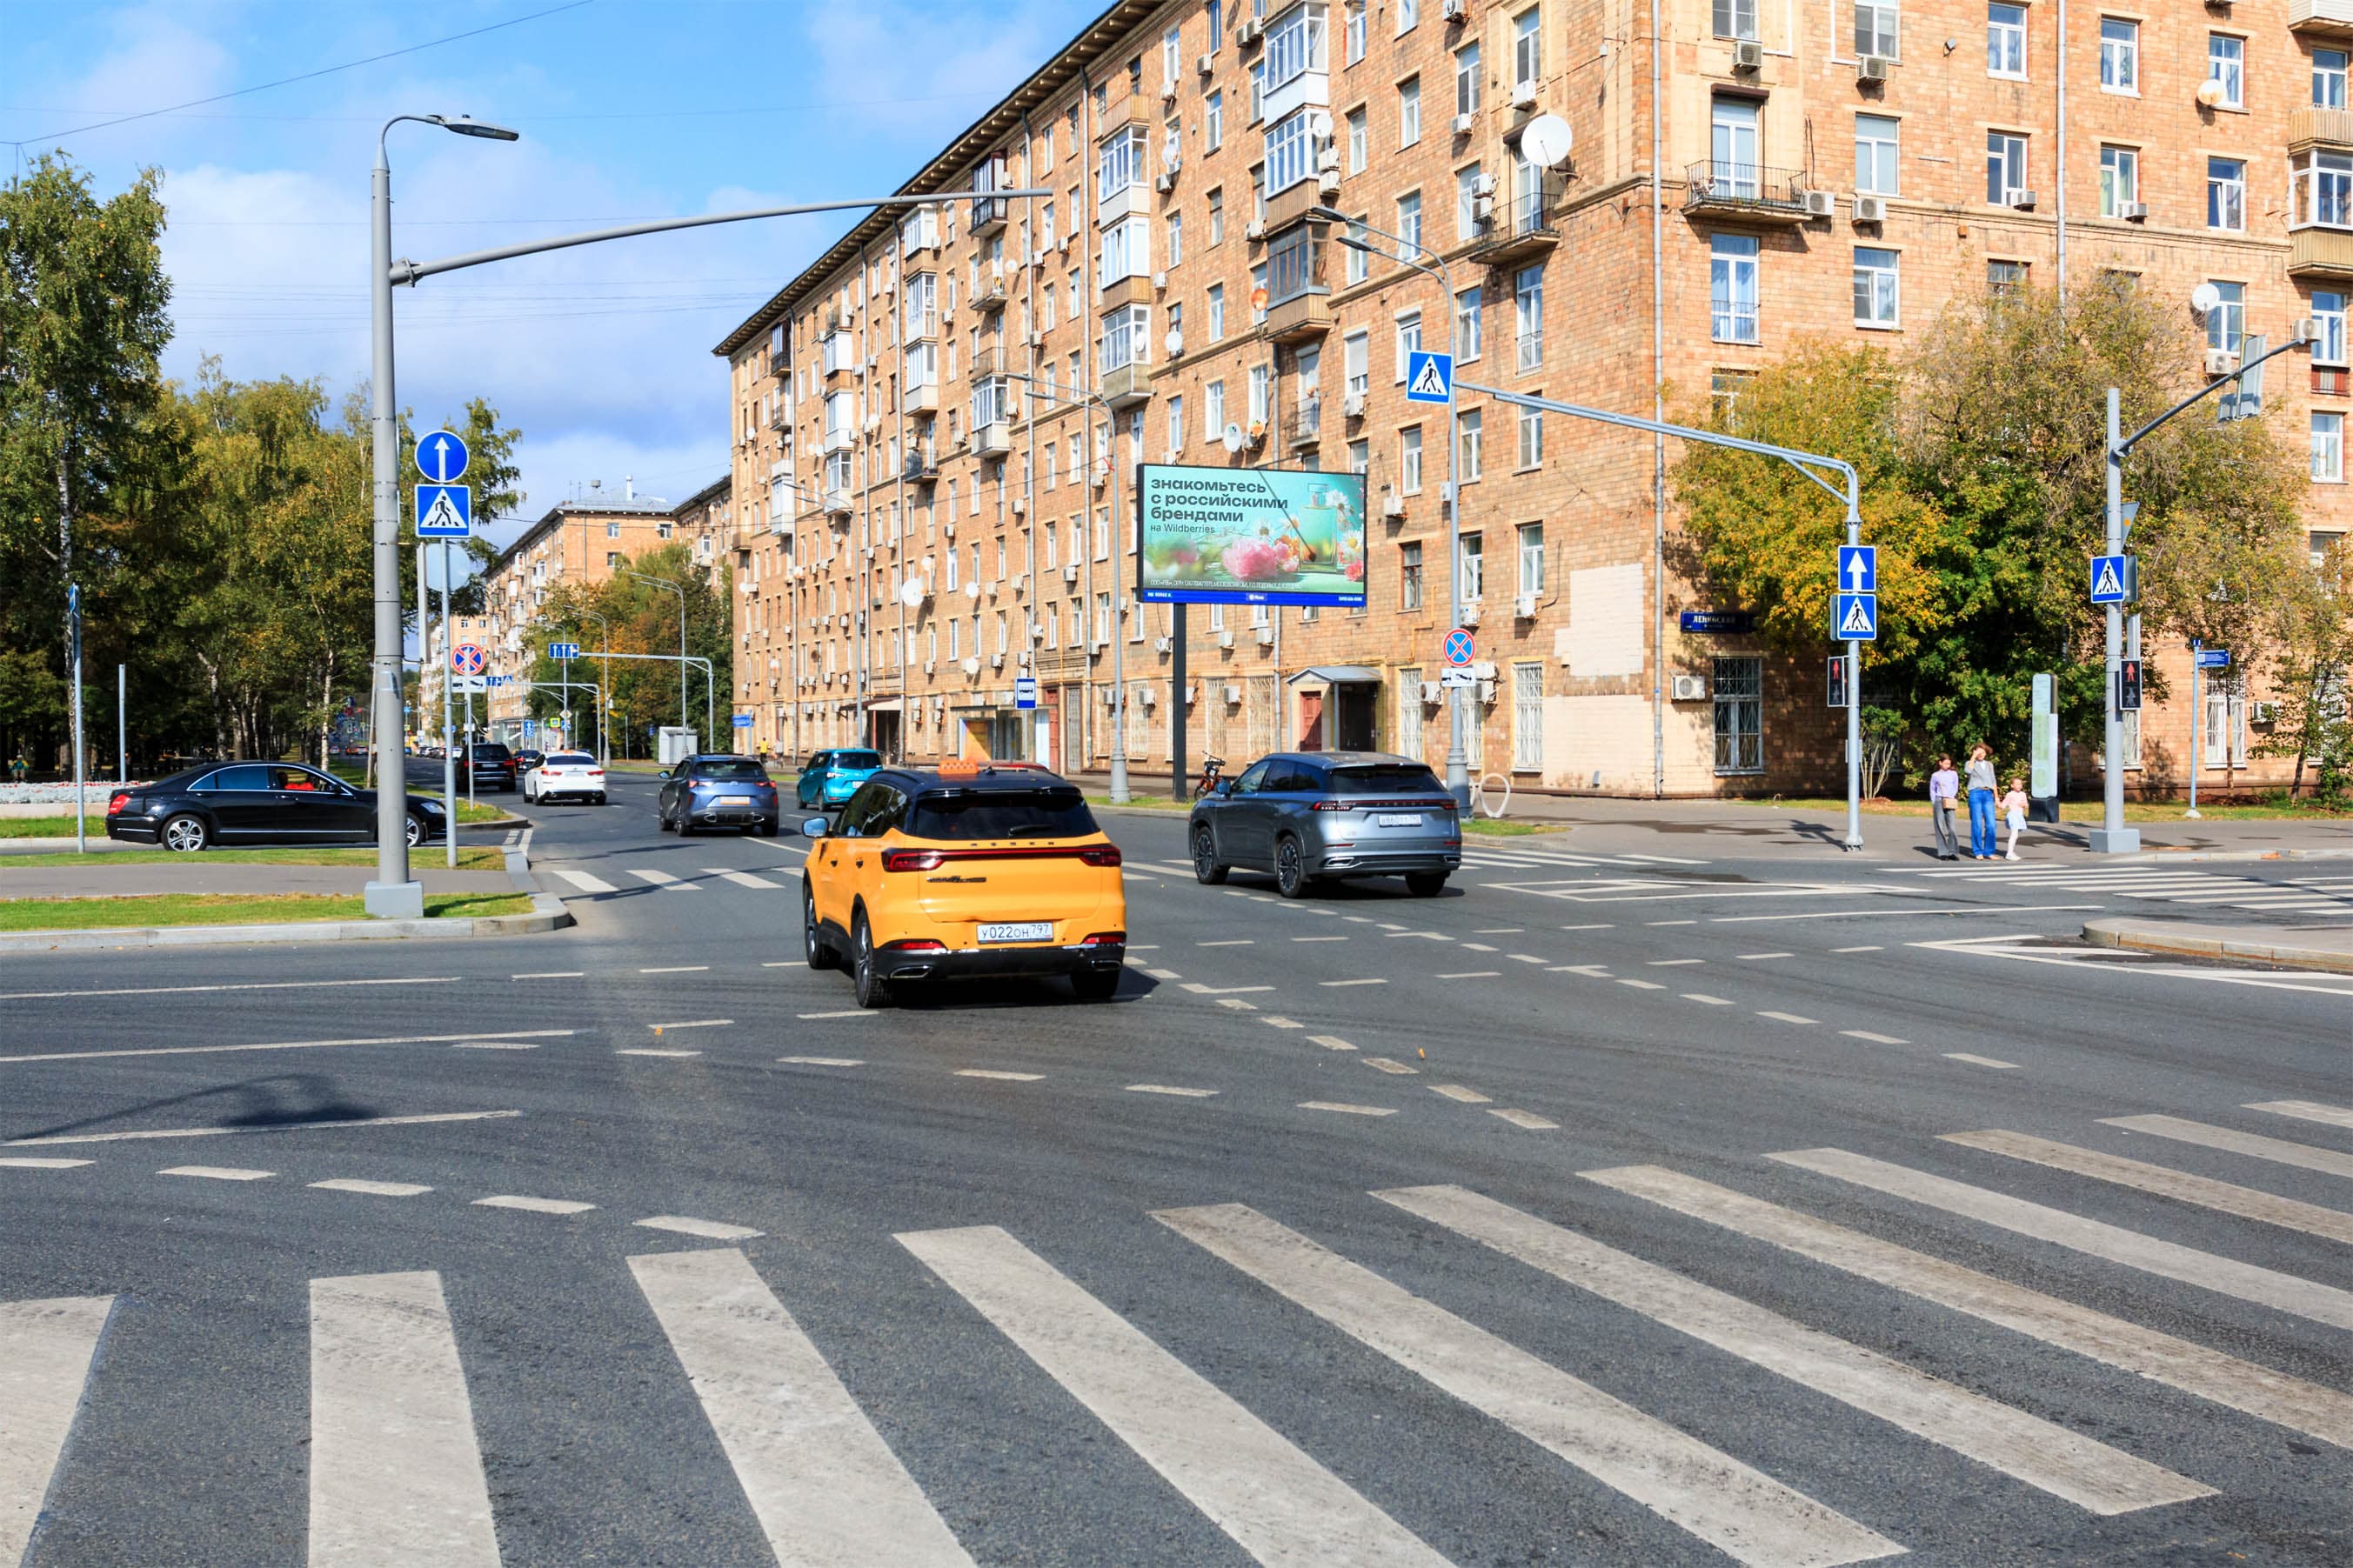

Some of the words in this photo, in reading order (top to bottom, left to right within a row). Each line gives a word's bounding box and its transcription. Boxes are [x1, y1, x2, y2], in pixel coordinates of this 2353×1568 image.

[1151, 479, 1266, 493] знакомьтесь
[1151, 494, 1161, 504] с
[1166, 493, 1287, 508] российскими
[1151, 507, 1243, 522] брендами
[1164, 524, 1215, 534] Wildberries
